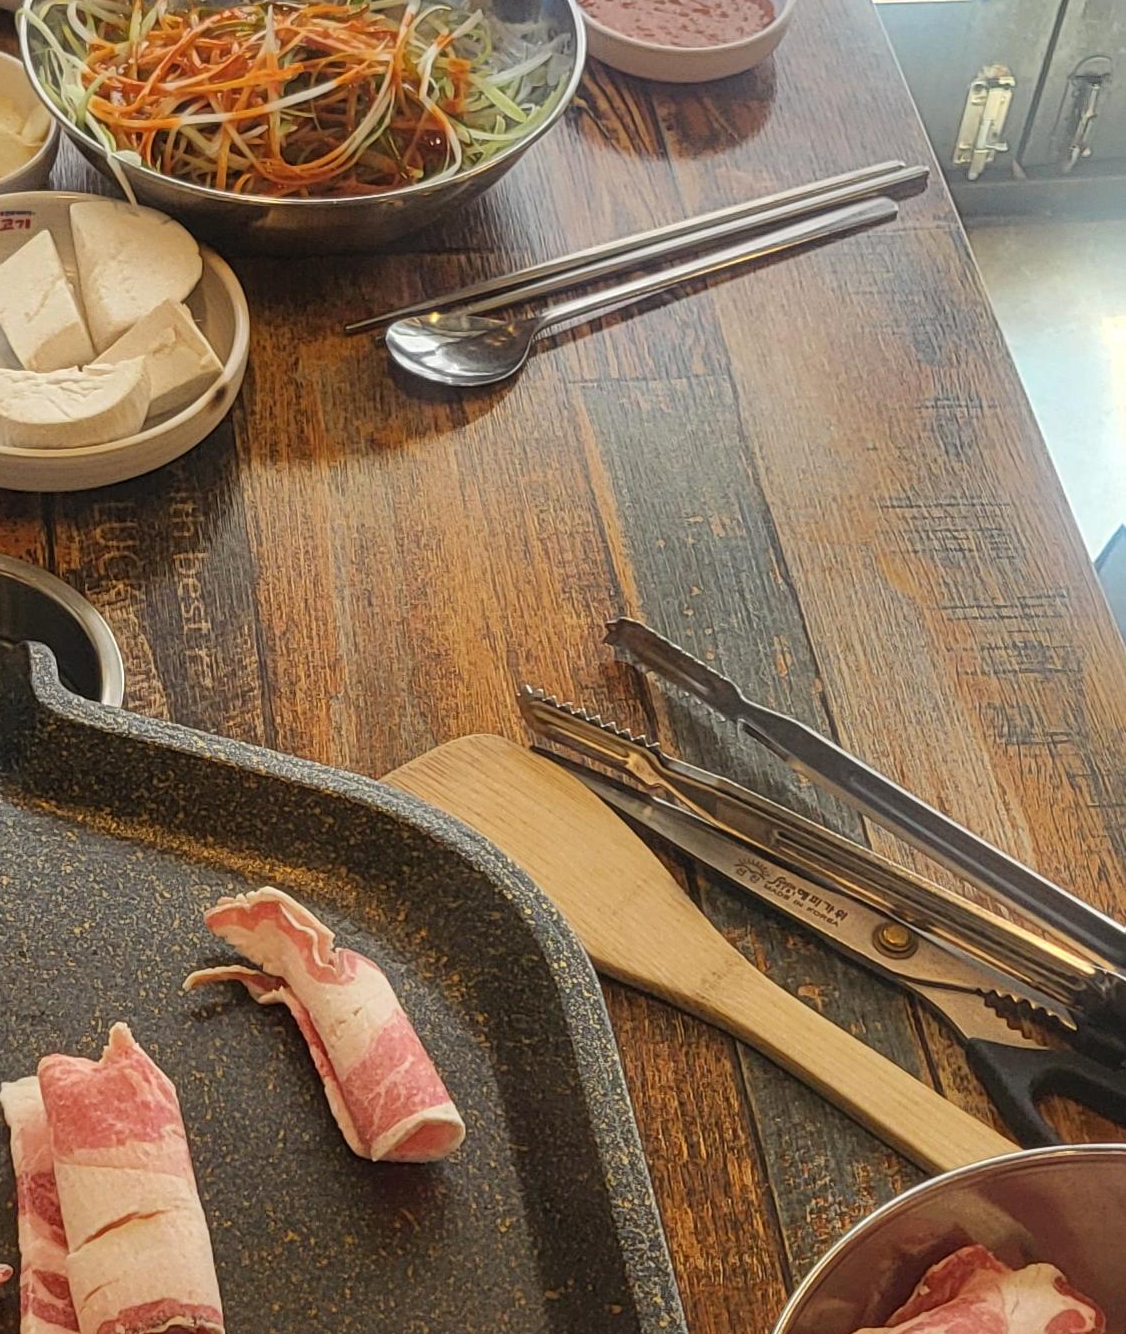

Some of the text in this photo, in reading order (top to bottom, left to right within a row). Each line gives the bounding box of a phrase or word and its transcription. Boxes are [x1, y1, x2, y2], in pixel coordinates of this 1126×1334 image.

[763, 883, 791, 901] MADE
[793, 899, 804, 908] IN
[806, 907, 839, 927] KOREA
